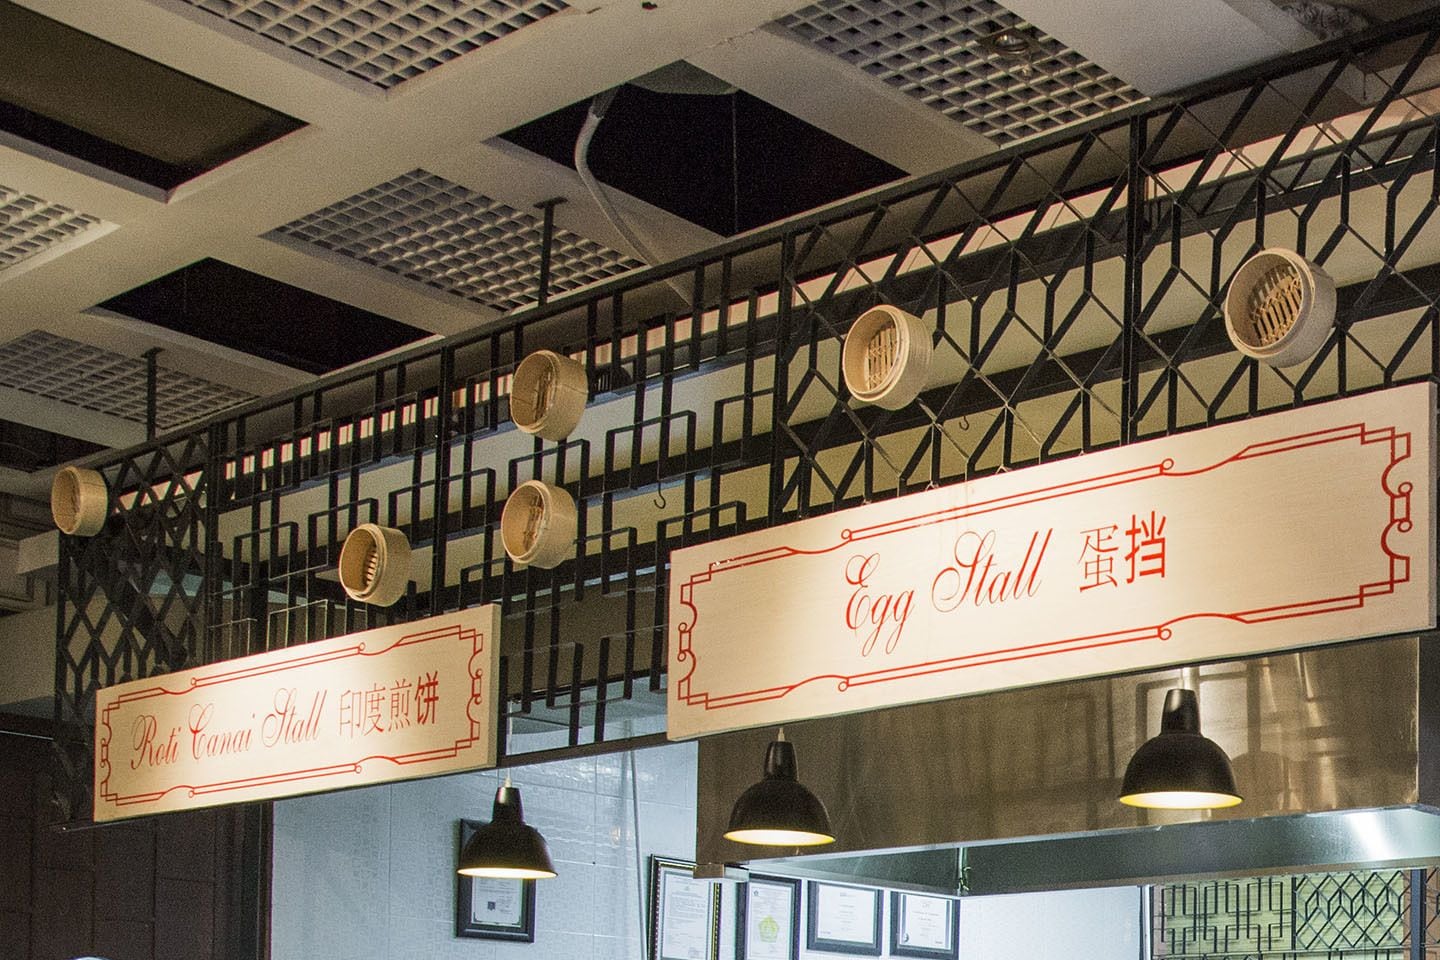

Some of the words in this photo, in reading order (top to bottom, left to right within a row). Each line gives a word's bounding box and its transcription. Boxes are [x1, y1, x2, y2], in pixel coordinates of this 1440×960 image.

[844, 552, 915, 658] Egg
[931, 527, 1053, 613] Stall
[1077, 510, 1167, 593] 蛋挡
[130, 713, 183, 771] Roti
[188, 702, 255, 761] Canai
[262, 687, 328, 748] Stall
[338, 670, 440, 740] 印度煎饼
